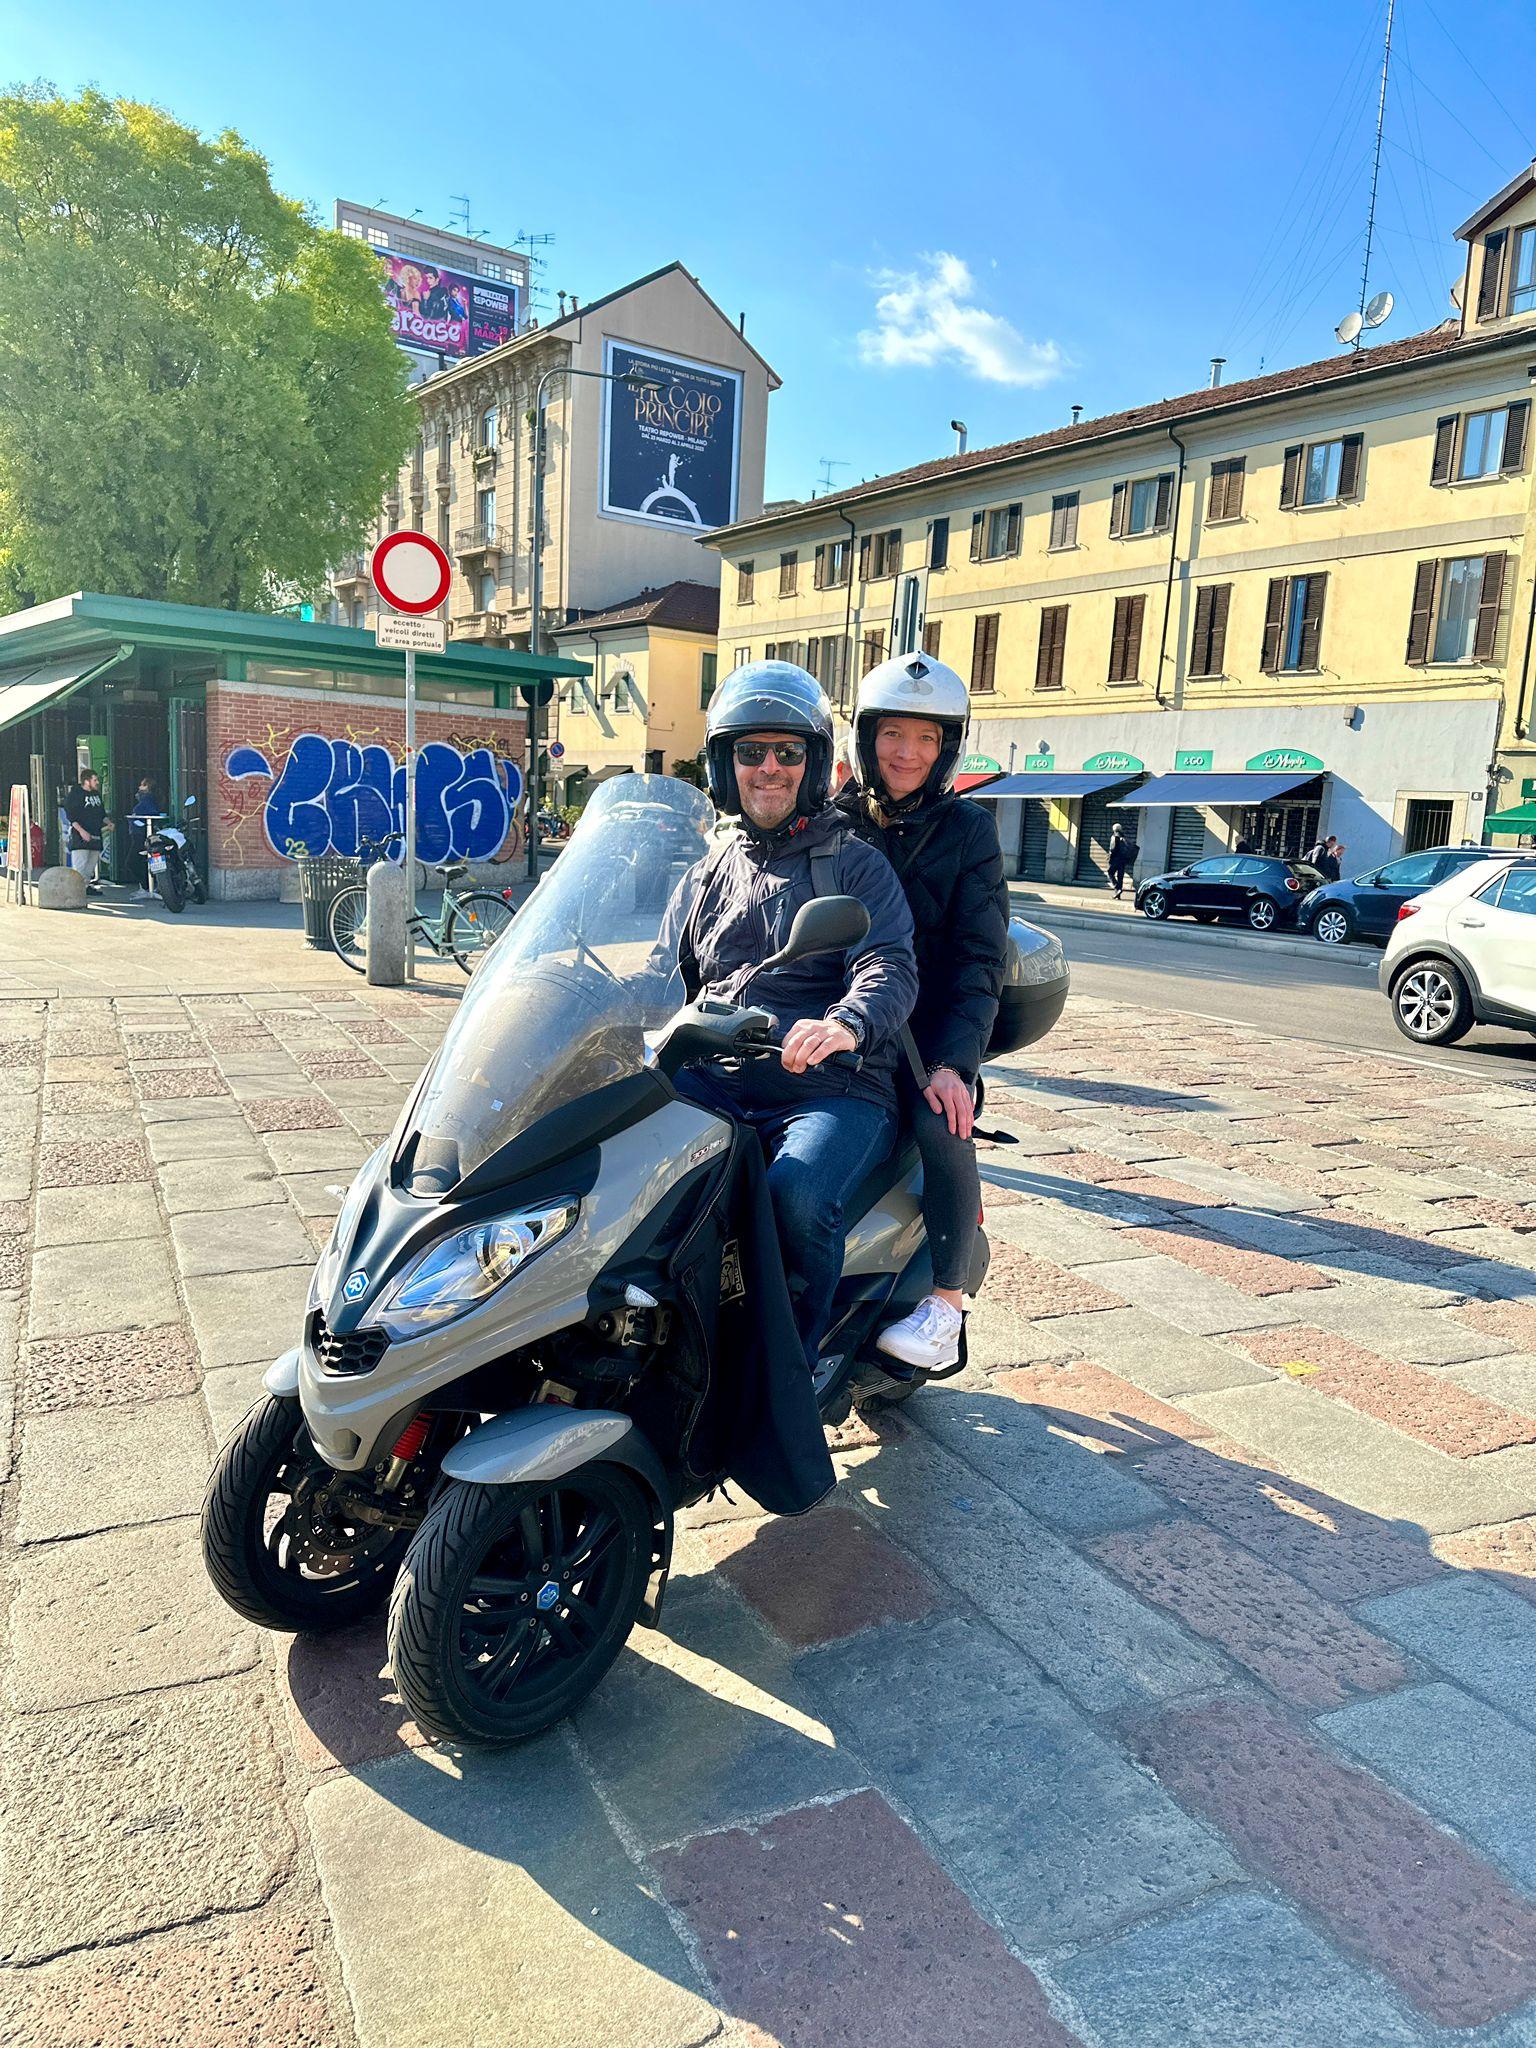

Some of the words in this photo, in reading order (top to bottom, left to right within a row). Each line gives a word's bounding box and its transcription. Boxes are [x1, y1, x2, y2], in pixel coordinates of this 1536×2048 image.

[483, 322, 489, 330] 2
[474, 328, 502, 341] MARZ
[659, 366, 671, 374] LETTA
[635, 398, 714, 438] PRINCIPE
[639, 424, 659, 435] TEATRO
[660, 430, 685, 441] REPOWER
[687, 437, 708, 446] MILANO
[658, 436, 671, 444] MARZO
[681, 442, 694, 450] APRILE
[385, 627, 409, 636] veicoli
[411, 630, 435, 638] diretti
[412, 640, 442, 649] portuale
[1183, 756, 1204, 766] &GO
[285, 837, 309, 858] 23
[690, 1145, 709, 1163] 300
